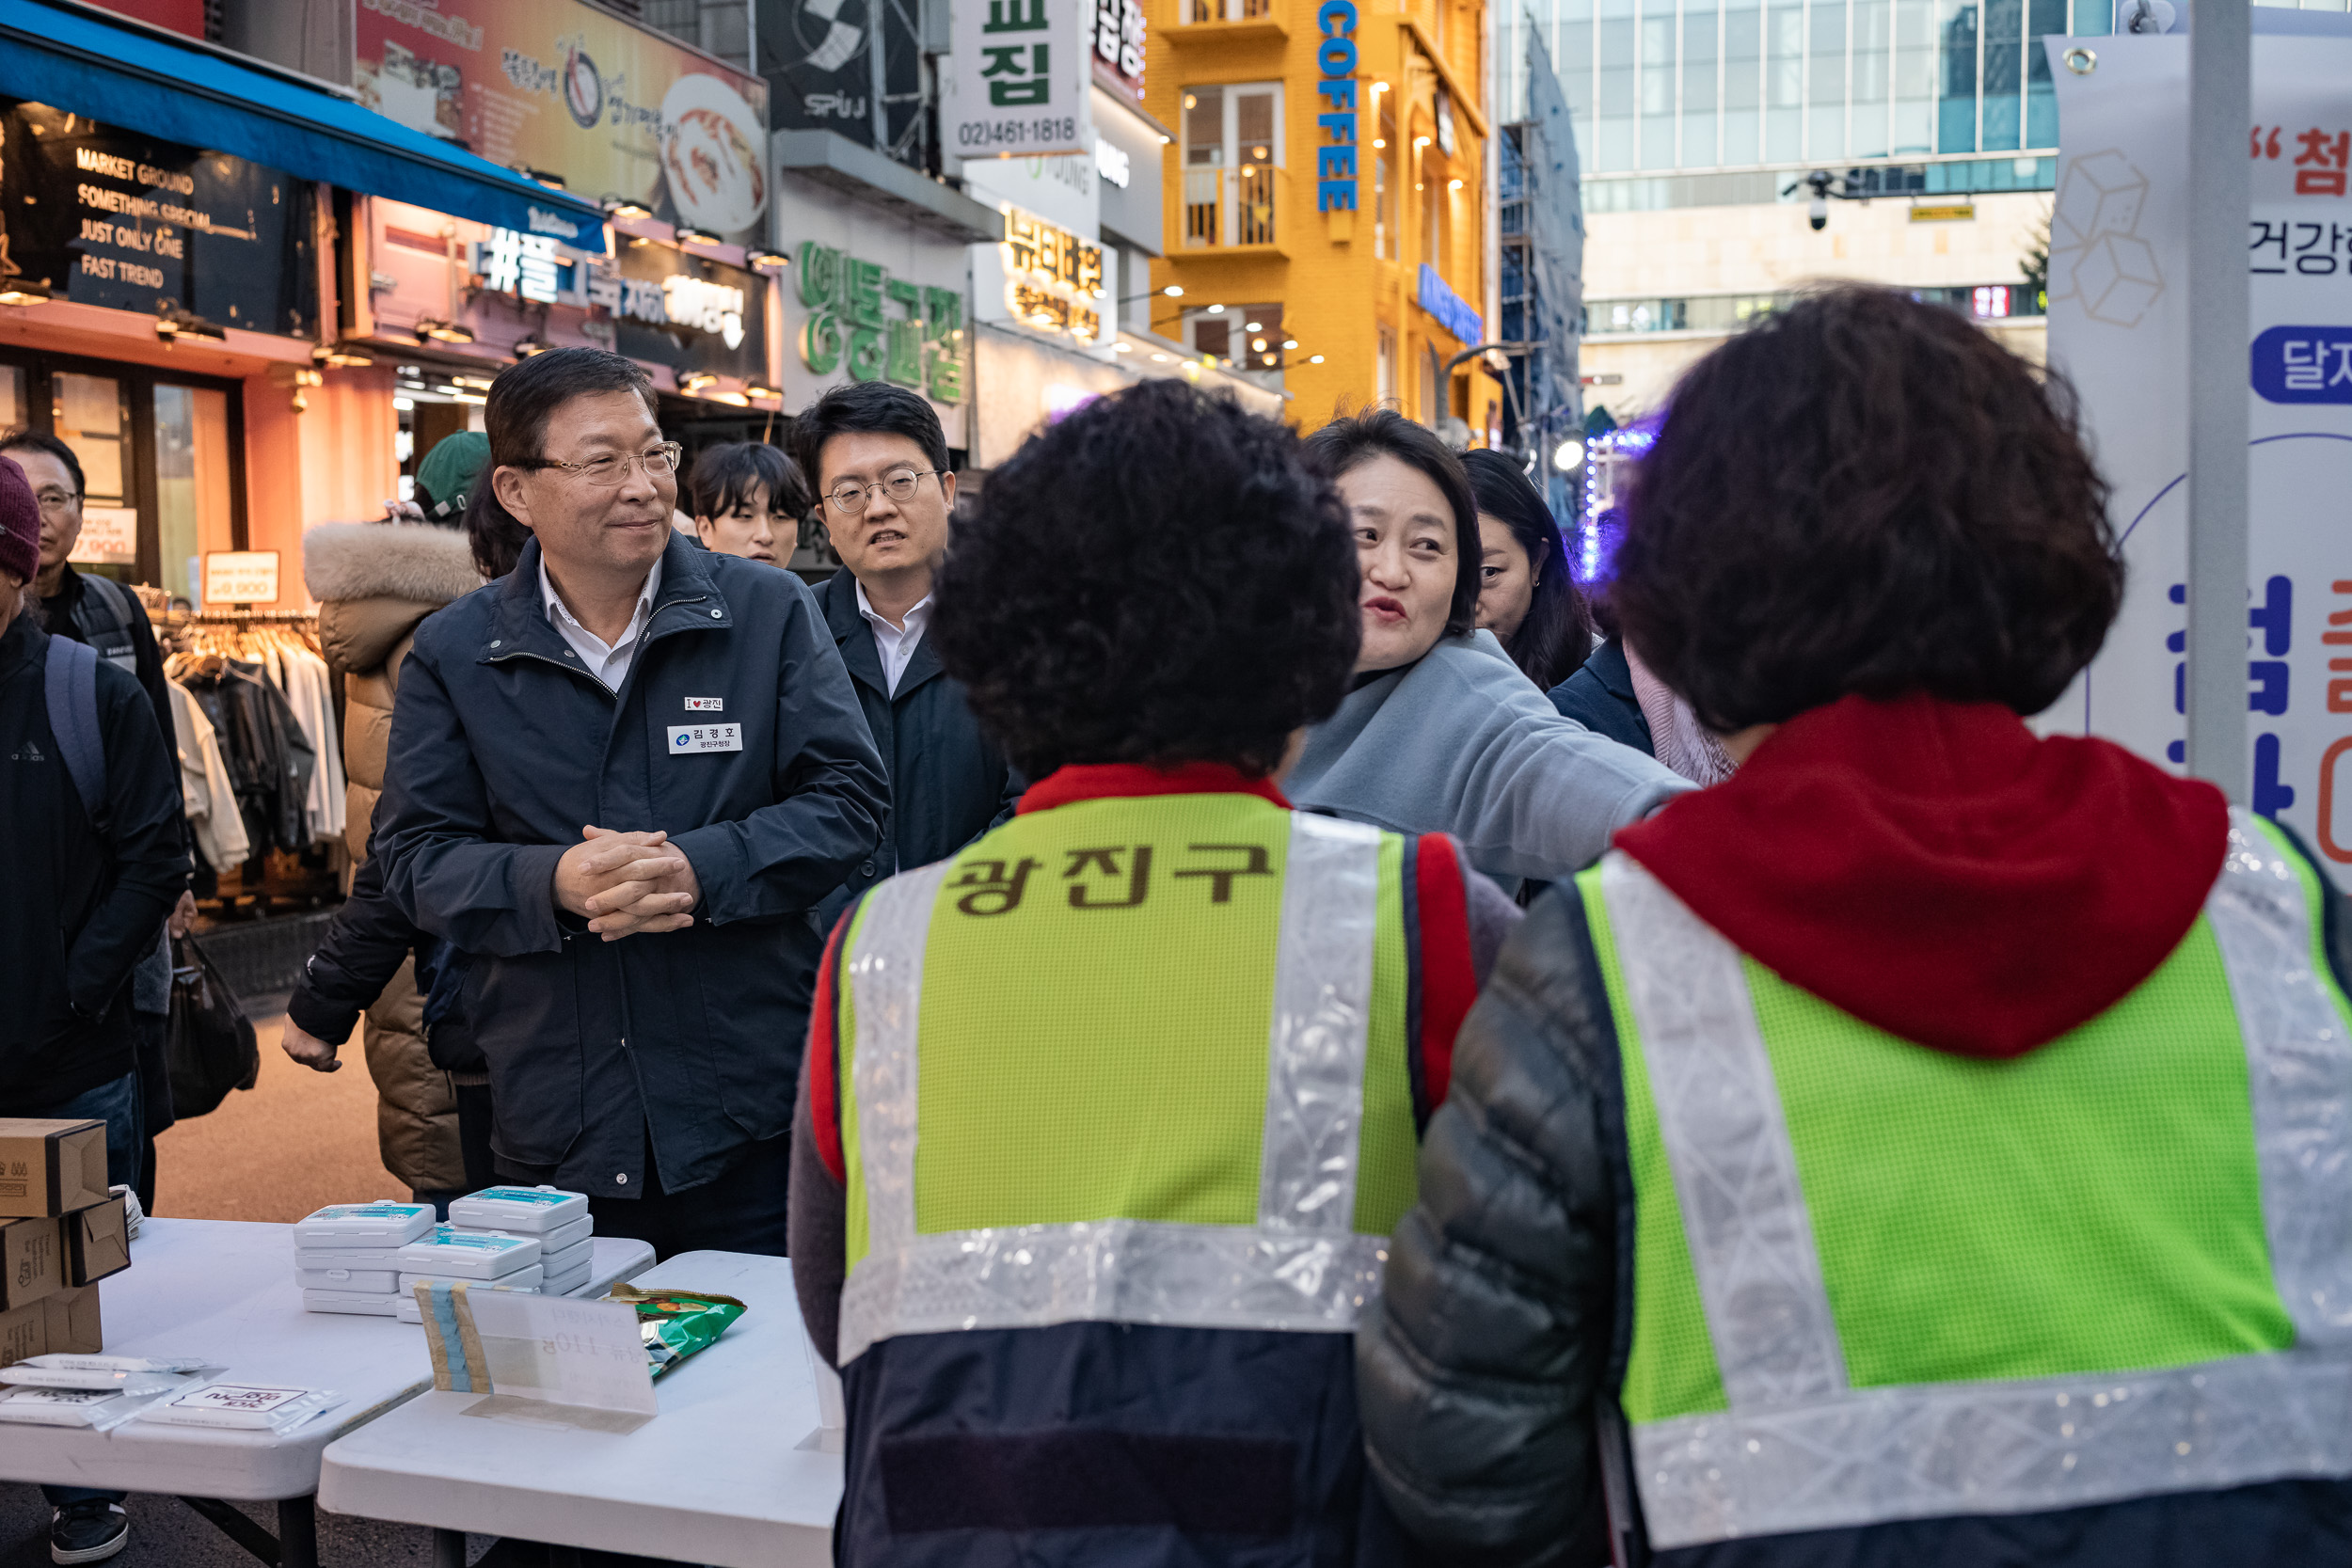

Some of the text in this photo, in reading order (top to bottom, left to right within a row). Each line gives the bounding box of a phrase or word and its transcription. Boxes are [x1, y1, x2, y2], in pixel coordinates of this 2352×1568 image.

[1318, 0, 1358, 212] COFFEE
[76, 147, 194, 196] MARKET GROUND
[2249, 126, 2352, 197] “첨
[78, 183, 158, 216] SOMETHING
[80, 218, 183, 260] JUST ONLY ONE
[2249, 221, 2352, 275] 건강
[81, 254, 164, 289] FAST TREND
[687, 698, 721, 709] I 광진
[946, 843, 1274, 917] 광진구
